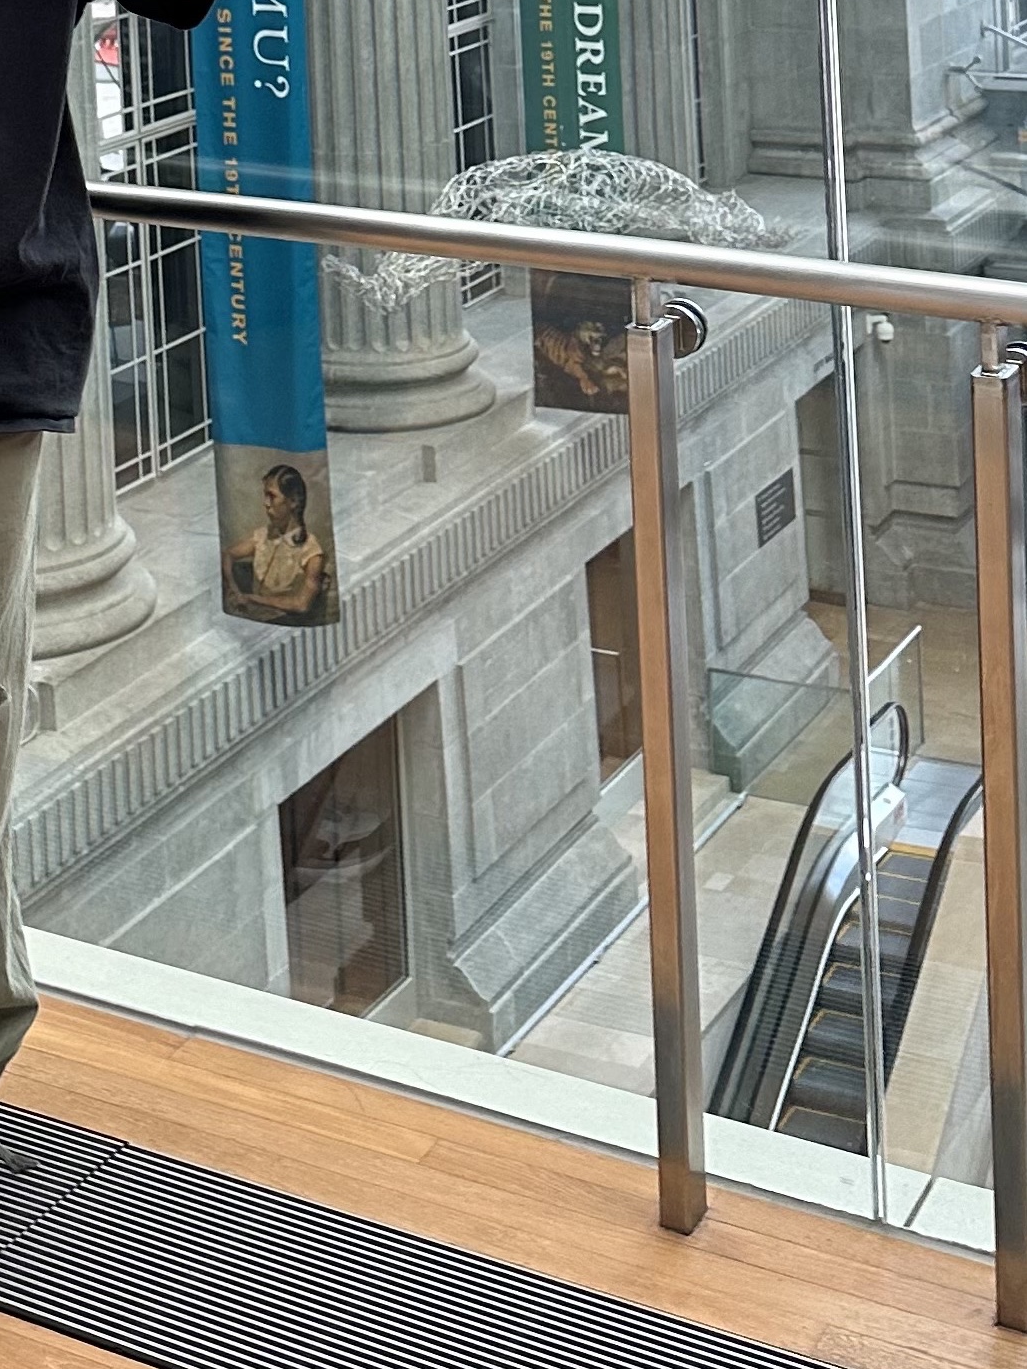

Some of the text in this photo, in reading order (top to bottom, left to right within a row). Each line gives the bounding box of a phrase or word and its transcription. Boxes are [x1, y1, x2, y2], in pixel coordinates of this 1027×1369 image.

[217, 8, 236, 87] SINCE
[541, 41, 555, 87] 19TH
[574, 1, 608, 151] DREAM
[222, 96, 239, 146] THE
[224, 157, 240, 196] 19T
